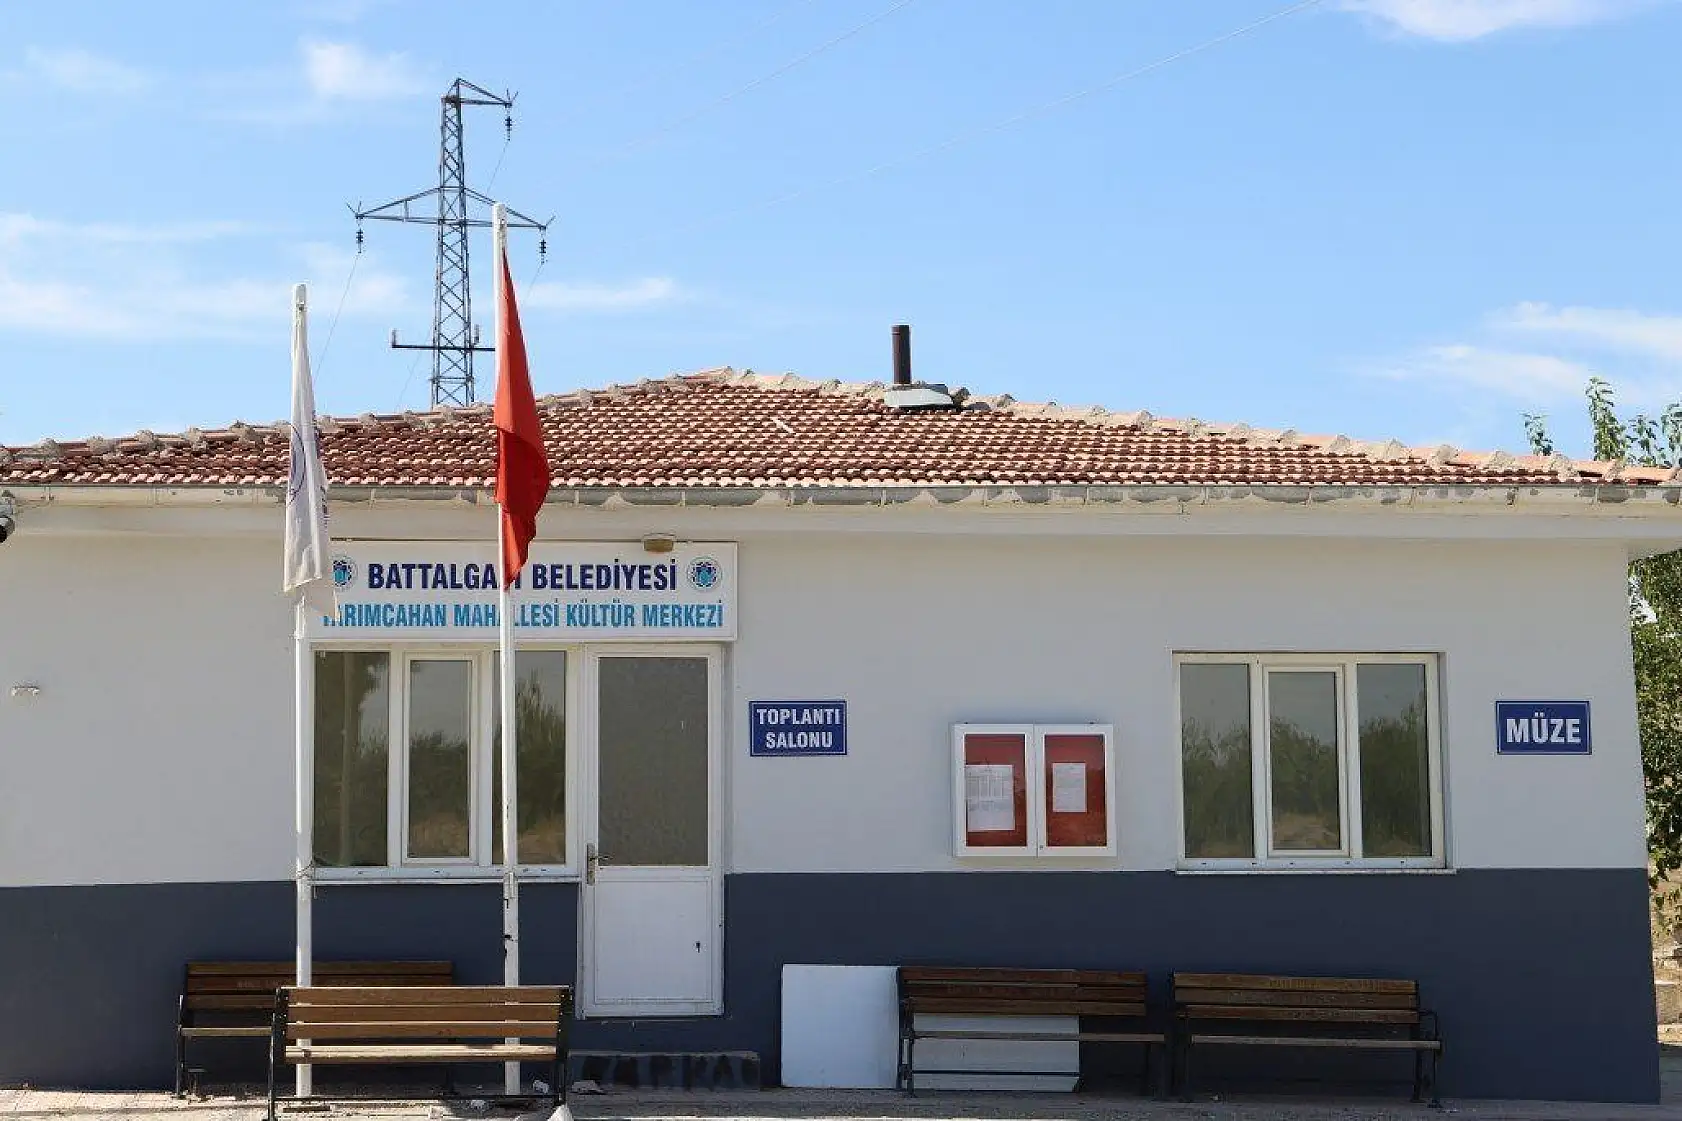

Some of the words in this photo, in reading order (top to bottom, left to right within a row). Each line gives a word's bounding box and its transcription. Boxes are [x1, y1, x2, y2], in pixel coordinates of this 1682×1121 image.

[368, 563, 521, 589] BATTALGA
[532, 558, 676, 590] BELEDİYESİ
[323, 604, 447, 627] RIMCAHAN
[454, 599, 560, 627] MAHLESİ
[566, 598, 635, 627] KÜLTÜR
[642, 599, 724, 627] MERKEZİ
[756, 708, 841, 725] TOPLANTI
[1506, 711, 1581, 744] MÜZE
[765, 731, 833, 749] SALONU
